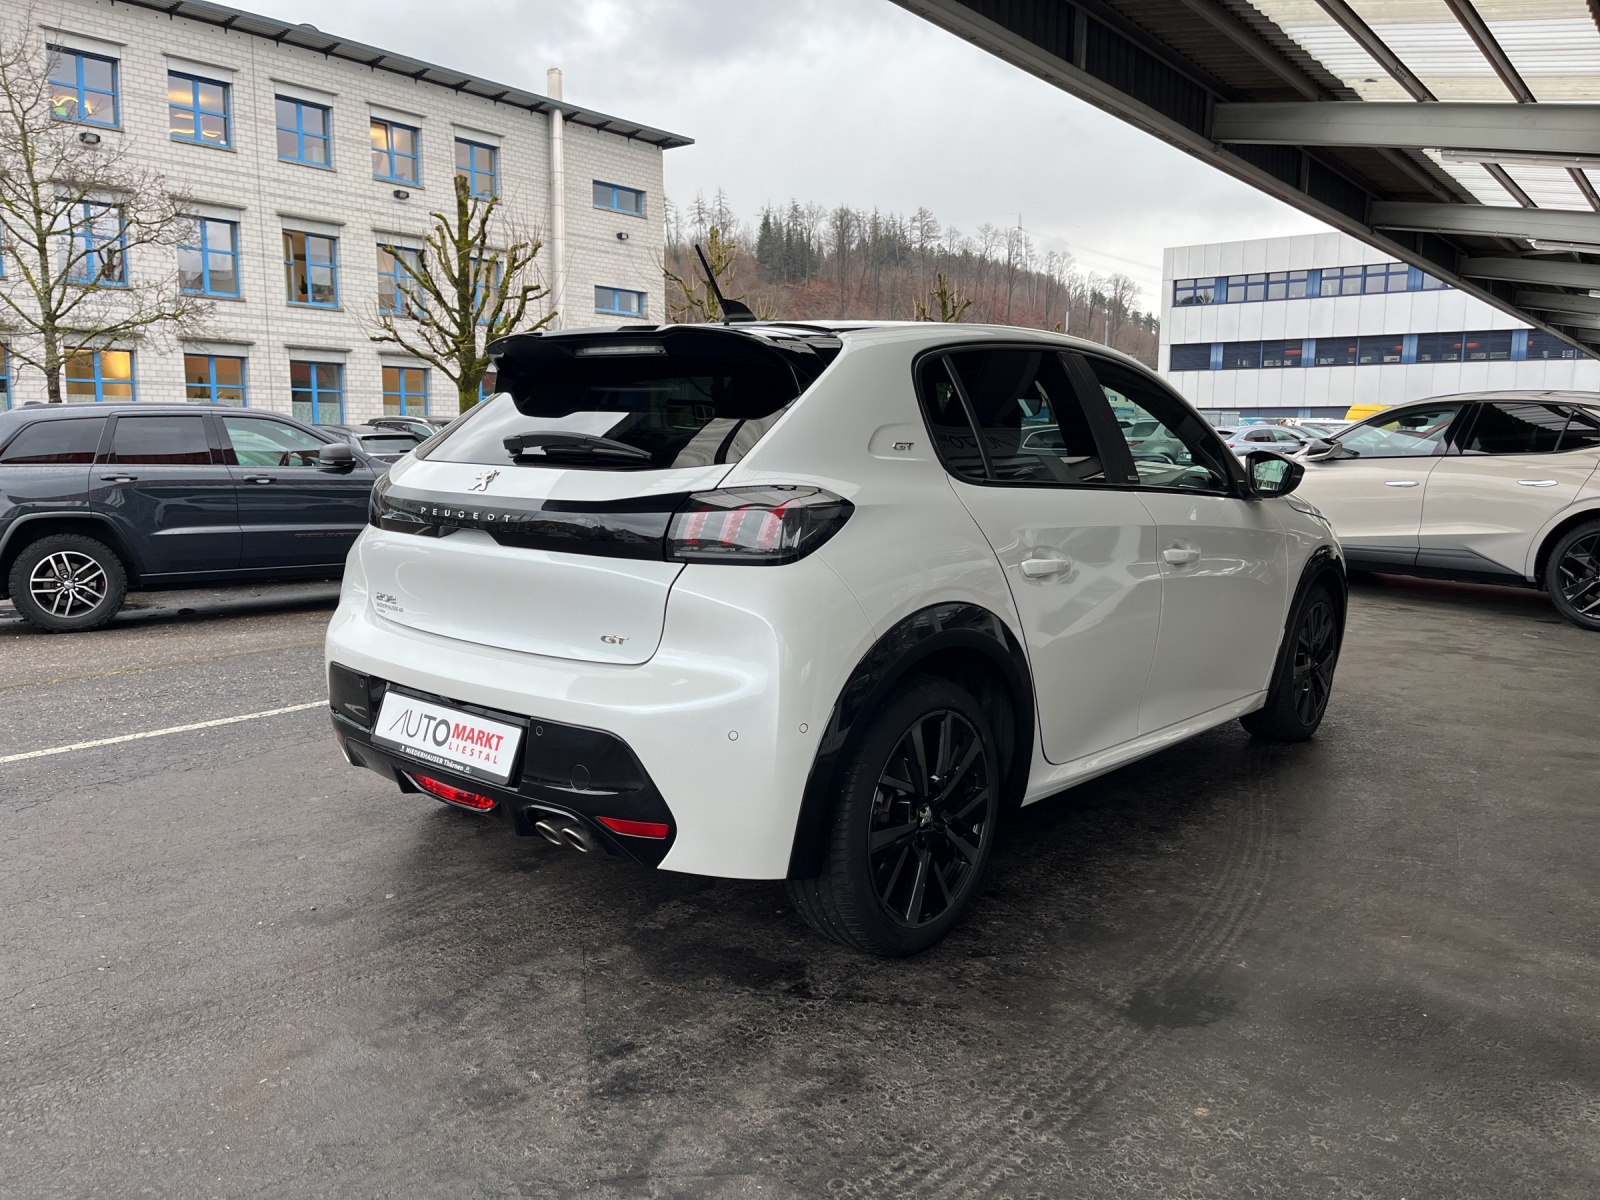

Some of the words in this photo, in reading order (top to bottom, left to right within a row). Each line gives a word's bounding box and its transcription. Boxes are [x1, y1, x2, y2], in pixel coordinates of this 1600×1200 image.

[892, 442, 915, 451] GT
[420, 506, 512, 523] PEUGEOT
[600, 635, 630, 645] GT
[449, 741, 498, 765] LIESTAL
